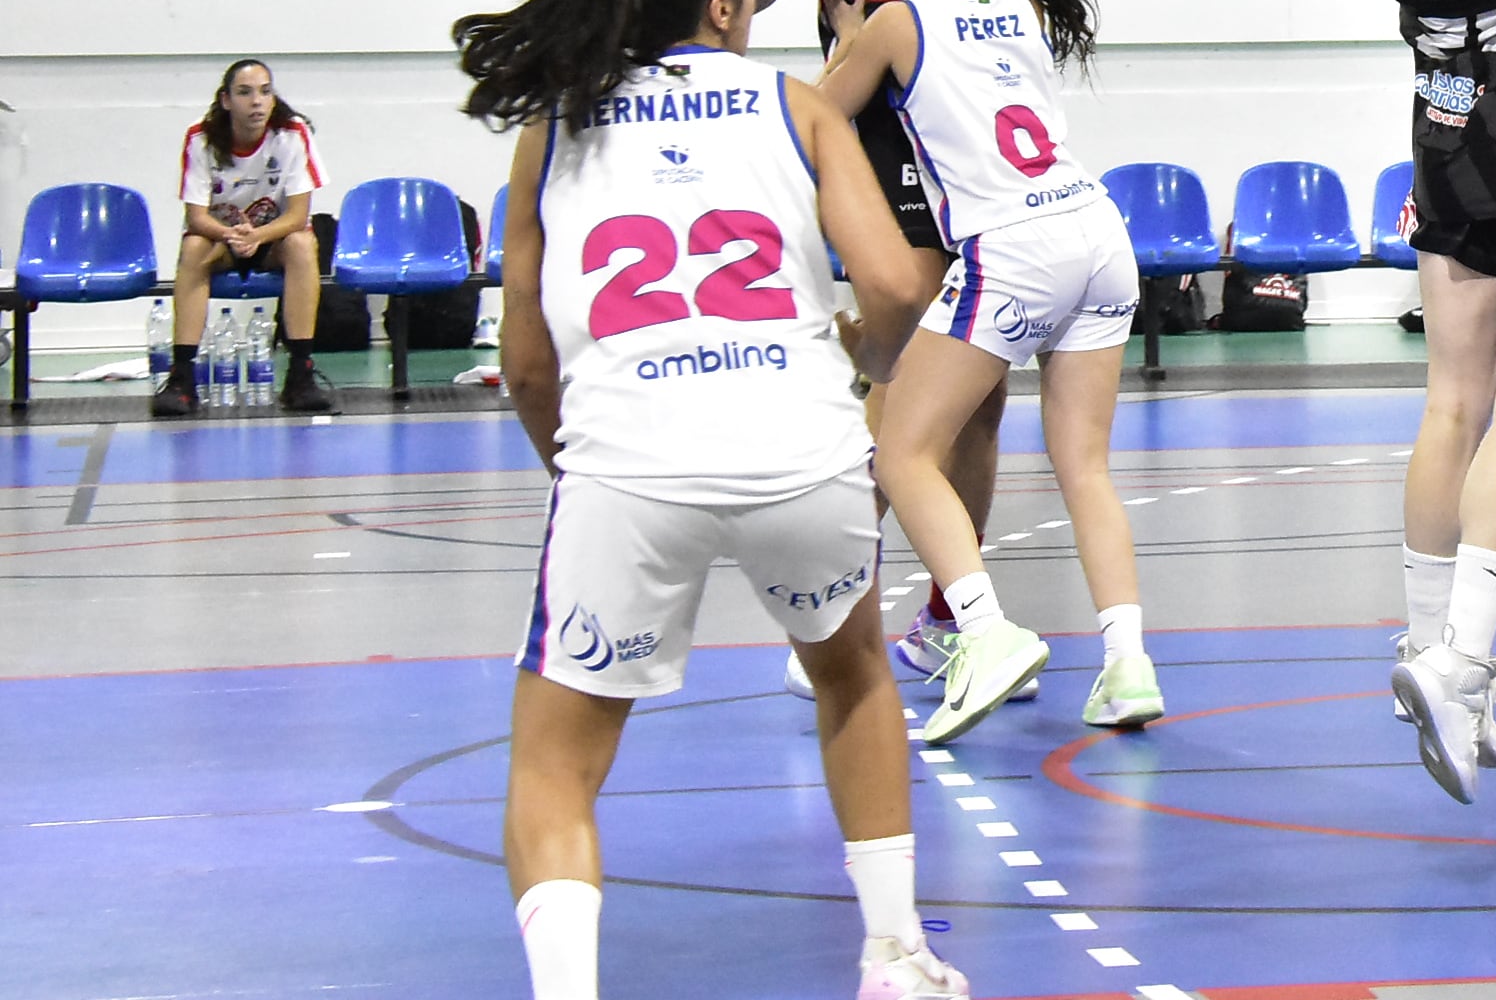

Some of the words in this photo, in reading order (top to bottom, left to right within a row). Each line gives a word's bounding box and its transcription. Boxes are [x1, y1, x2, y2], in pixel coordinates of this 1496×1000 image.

[955, 14, 1025, 41] PÉREZ
[582, 209, 798, 341] 22
[637, 341, 787, 380] ambling
[617, 638, 663, 662] MED
